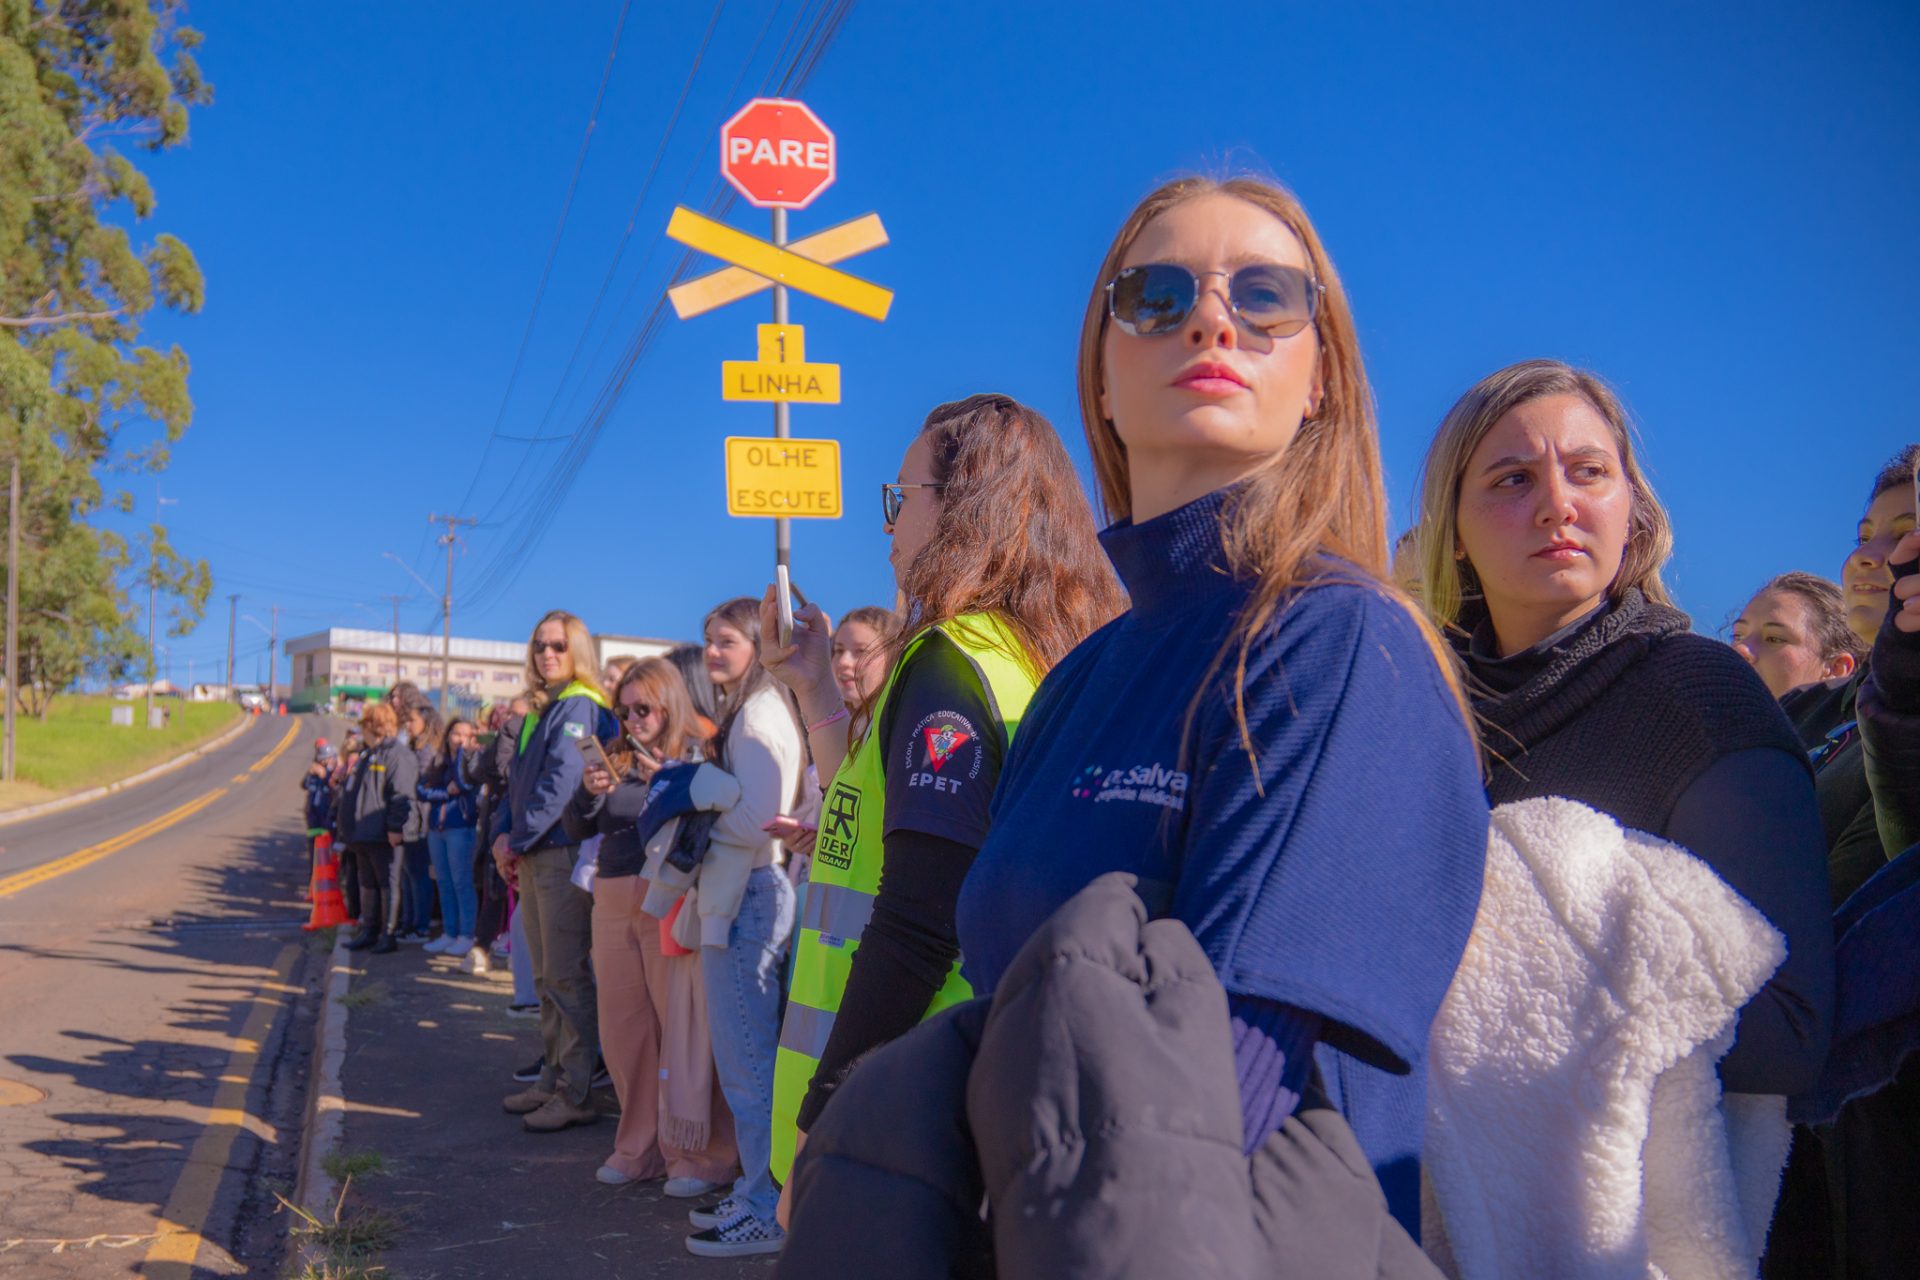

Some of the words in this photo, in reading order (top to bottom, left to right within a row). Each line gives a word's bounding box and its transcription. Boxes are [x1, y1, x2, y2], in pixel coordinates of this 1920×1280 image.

[730, 137, 829, 170] PARE
[775, 335, 785, 363] 1
[740, 374, 823, 395] LINHA
[747, 446, 818, 468] OLHE
[737, 489, 832, 509] ESCUTE
[908, 772, 962, 794] EPET
[821, 836, 849, 857] DER
